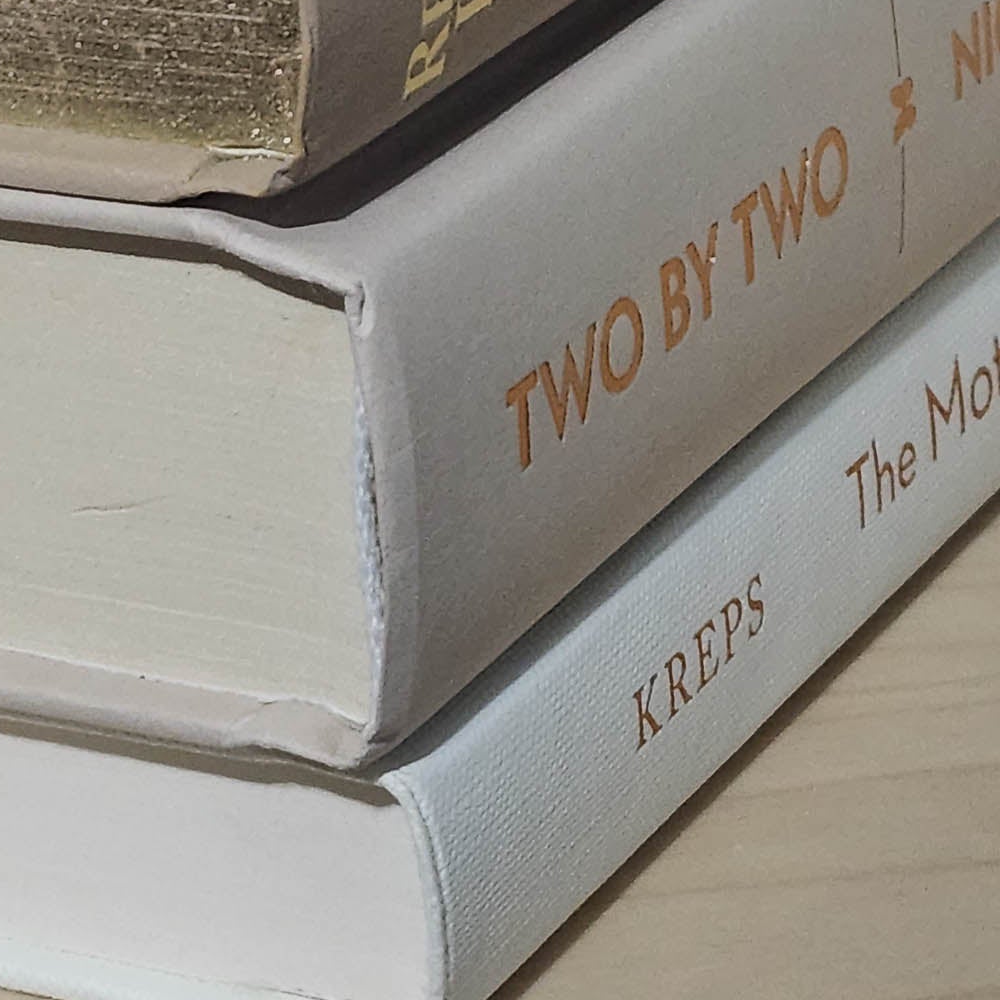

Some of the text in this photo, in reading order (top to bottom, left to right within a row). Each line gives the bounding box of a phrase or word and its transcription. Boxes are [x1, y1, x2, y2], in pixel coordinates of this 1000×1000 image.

[505, 125, 849, 473] TWO BY TWO
[844, 438, 917, 529] The
[632, 573, 766, 751] KREPS
